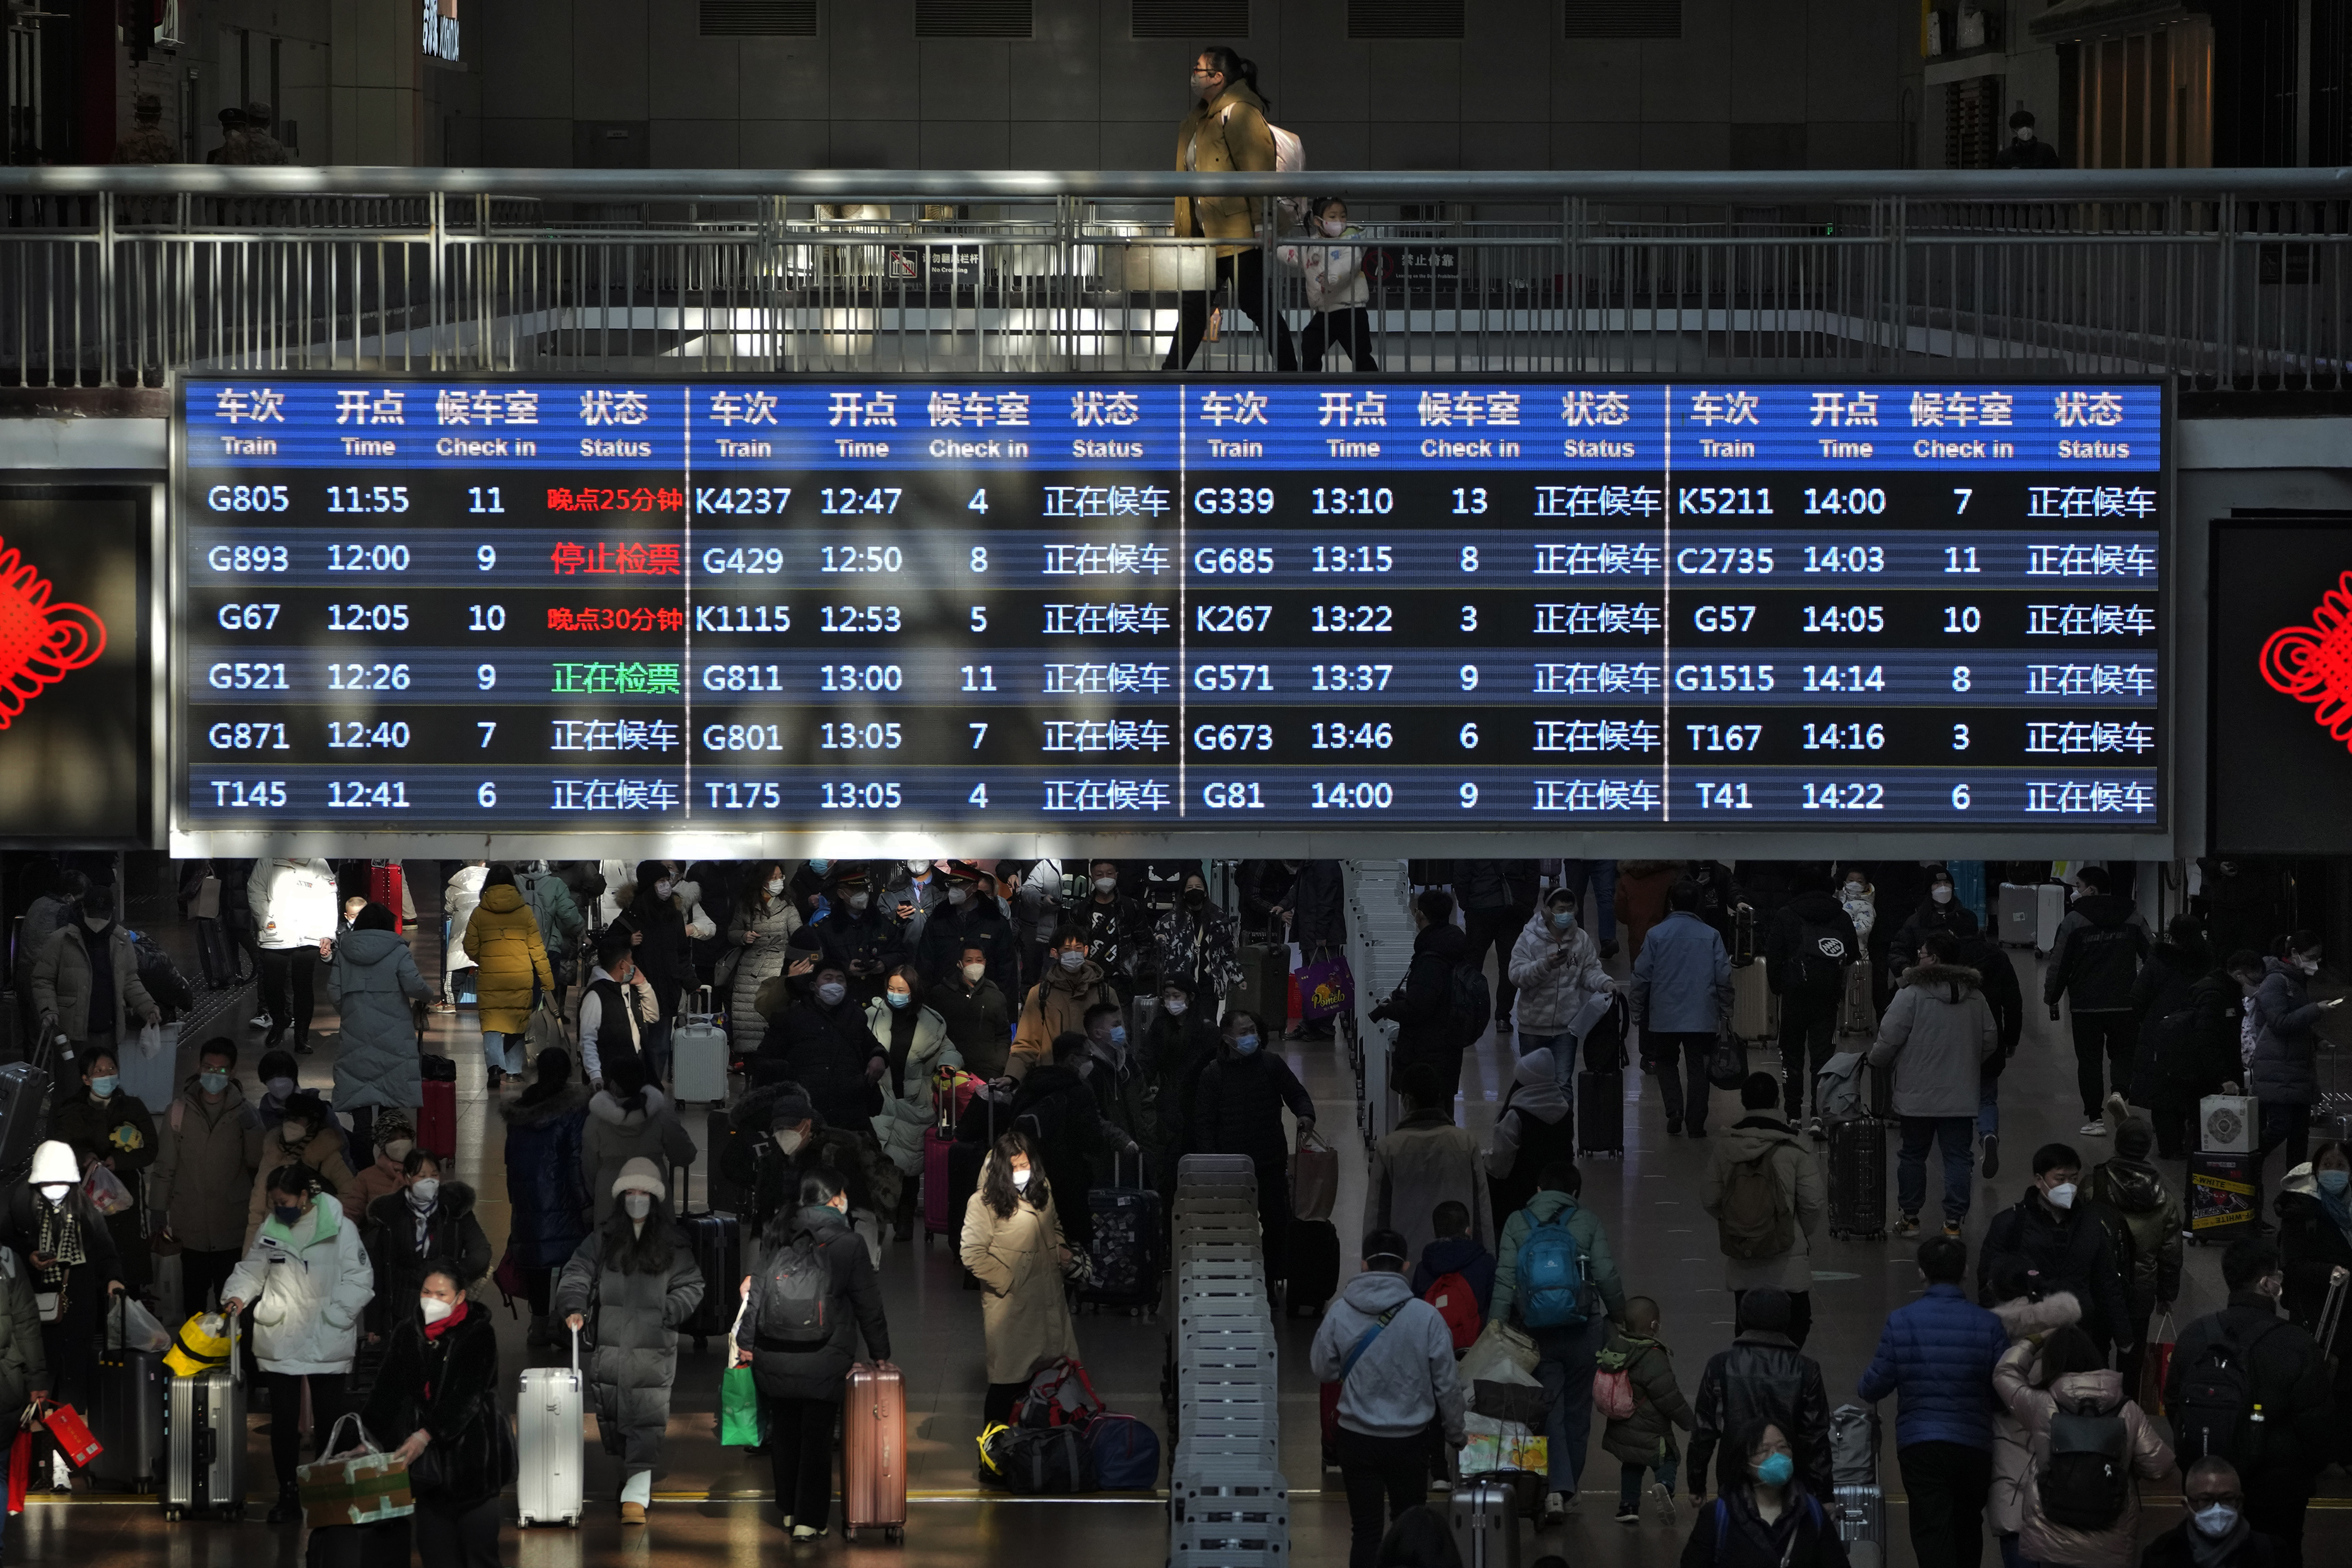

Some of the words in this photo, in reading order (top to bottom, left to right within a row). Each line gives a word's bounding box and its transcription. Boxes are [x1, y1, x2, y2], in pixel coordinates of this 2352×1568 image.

[922, 253, 979, 264] 勿翻栏杆
[217, 388, 285, 423] 车次
[336, 389, 405, 425] 开点
[436, 390, 538, 425] 候车室
[581, 390, 648, 425] 状态
[711, 391, 778, 426] 车次
[829, 391, 897, 426] 开点
[927, 392, 1029, 426] 候车室
[1073, 391, 1138, 426] 状态
[1201, 391, 1268, 426] 车次
[1319, 391, 1387, 426] 开点
[1419, 391, 1520, 426] 候车室
[1563, 391, 1629, 426] 状态
[1691, 391, 1759, 426] 车次
[1810, 391, 1879, 426] 开点
[1910, 392, 2013, 426] 候车室
[2055, 392, 2123, 426] 状态
[222, 436, 277, 454] Train
[341, 437, 396, 455] Time
[437, 438, 507, 456] Check
[516, 438, 536, 456] in
[581, 439, 651, 456] Status
[717, 439, 771, 457] Train
[835, 439, 889, 457] Time
[929, 439, 1000, 457] Check
[1008, 440, 1028, 457] in
[1073, 439, 1143, 457] Status
[1209, 439, 1263, 457] Train
[1327, 439, 1380, 457] Time
[1421, 439, 1492, 457] Check
[1500, 439, 1520, 457] in
[1564, 439, 1635, 457] Status
[1700, 439, 1755, 457] Train
[1819, 439, 1873, 457] Time
[1914, 439, 1986, 457] Check
[1993, 440, 2014, 457] in
[2059, 440, 2129, 458] Status
[209, 485, 289, 511] G805
[327, 486, 409, 512] 11:55
[469, 487, 505, 513] 11
[547, 488, 683, 512] 晚点25分钟
[696, 488, 791, 514] K4237
[821, 488, 902, 514] 12:47
[968, 488, 988, 514] 4
[1044, 486, 1170, 517] 正在候车
[1194, 488, 1274, 514] G339
[1312, 488, 1393, 514] 13:10
[1453, 488, 1487, 514] 13
[1534, 485, 1661, 517] 正在候车
[1679, 488, 1773, 514] K5211
[1804, 488, 1886, 514] 14:00
[1954, 489, 1972, 514] 7
[2028, 486, 2156, 518] 正在候车
[209, 546, 288, 571] G893
[328, 544, 410, 570] 12:00
[477, 545, 496, 571] 9
[551, 542, 680, 575] 停止检票
[703, 548, 783, 573] G429
[822, 546, 902, 572] 12:50
[970, 547, 987, 572] 8
[1043, 543, 1170, 575] 正在候车
[1195, 548, 1274, 573] G685
[1312, 546, 1392, 572] 13:15
[1461, 546, 1478, 572] 8
[1534, 543, 1661, 575] 正在候车
[1677, 548, 1773, 573] C2735
[1804, 546, 1884, 572] 14:03
[1945, 547, 1980, 572] 11
[2027, 544, 2155, 576] 正在候车
[219, 604, 280, 629] G67
[328, 604, 408, 630] 12:05
[469, 605, 505, 630] 10
[548, 607, 683, 631] 晚点30分钟
[697, 606, 790, 632] K1115
[821, 606, 901, 632] 12:53
[971, 606, 987, 632] 5
[1043, 603, 1170, 634] 正在候车
[1198, 606, 1272, 632] K267
[1312, 606, 1392, 632] 13:22
[1461, 606, 1477, 631] 3
[1534, 603, 1661, 634] 正在候车
[1695, 606, 1756, 632] G57
[1804, 606, 1884, 632] 14:05
[1944, 607, 1981, 632] 10
[2027, 604, 2156, 636] 正在候车
[209, 663, 289, 689] G521
[328, 664, 410, 689] 12:26
[478, 664, 495, 690] 9
[552, 662, 681, 694] 正在检票
[703, 665, 782, 690] G811
[821, 665, 902, 691] 13:00
[961, 666, 996, 691] 11
[1044, 662, 1170, 694] 正在候车
[1194, 665, 1273, 690] G571
[1312, 665, 1393, 690] 13:37
[1461, 665, 1478, 690] 9
[1534, 662, 1661, 694] 正在候车
[1675, 665, 1774, 691] G1515
[1803, 665, 1885, 691] 14:14
[1952, 666, 1971, 691] 8
[2026, 664, 2154, 696] 正在候车
[209, 723, 290, 749] G871
[328, 722, 410, 747] 12:40
[477, 722, 496, 748] 7
[551, 719, 679, 751] 正在候车
[704, 725, 783, 750] G801
[822, 723, 901, 748] 13:05
[969, 723, 988, 749] 7
[1043, 720, 1169, 751] 正在候车
[1194, 725, 1272, 750] G673
[1312, 723, 1393, 748] 13:46
[1460, 723, 1478, 748] 6
[1533, 720, 1661, 752] 正在候车
[1687, 725, 1762, 751] T167
[1803, 723, 1885, 749] 14:16
[1954, 724, 1970, 750] 3
[2025, 721, 2154, 754] 正在候车
[211, 781, 286, 806] T145
[328, 782, 410, 807] 12:41
[478, 782, 496, 808] 6
[551, 779, 679, 810] 正在候车
[705, 783, 780, 808] T175
[821, 783, 901, 808] 13:05
[969, 783, 988, 808] 4
[1043, 779, 1170, 811] 正在候车
[1203, 782, 1265, 808] G81
[1312, 783, 1393, 808] 14:00
[1460, 783, 1478, 808] 9
[1533, 779, 1661, 811] 正在候车
[1696, 783, 1753, 808] T41
[1803, 783, 1884, 809] 14:22
[1952, 784, 1970, 809] 6
[2025, 781, 2154, 813] 正在候车
[1311, 989, 1345, 1009] Pomelo
